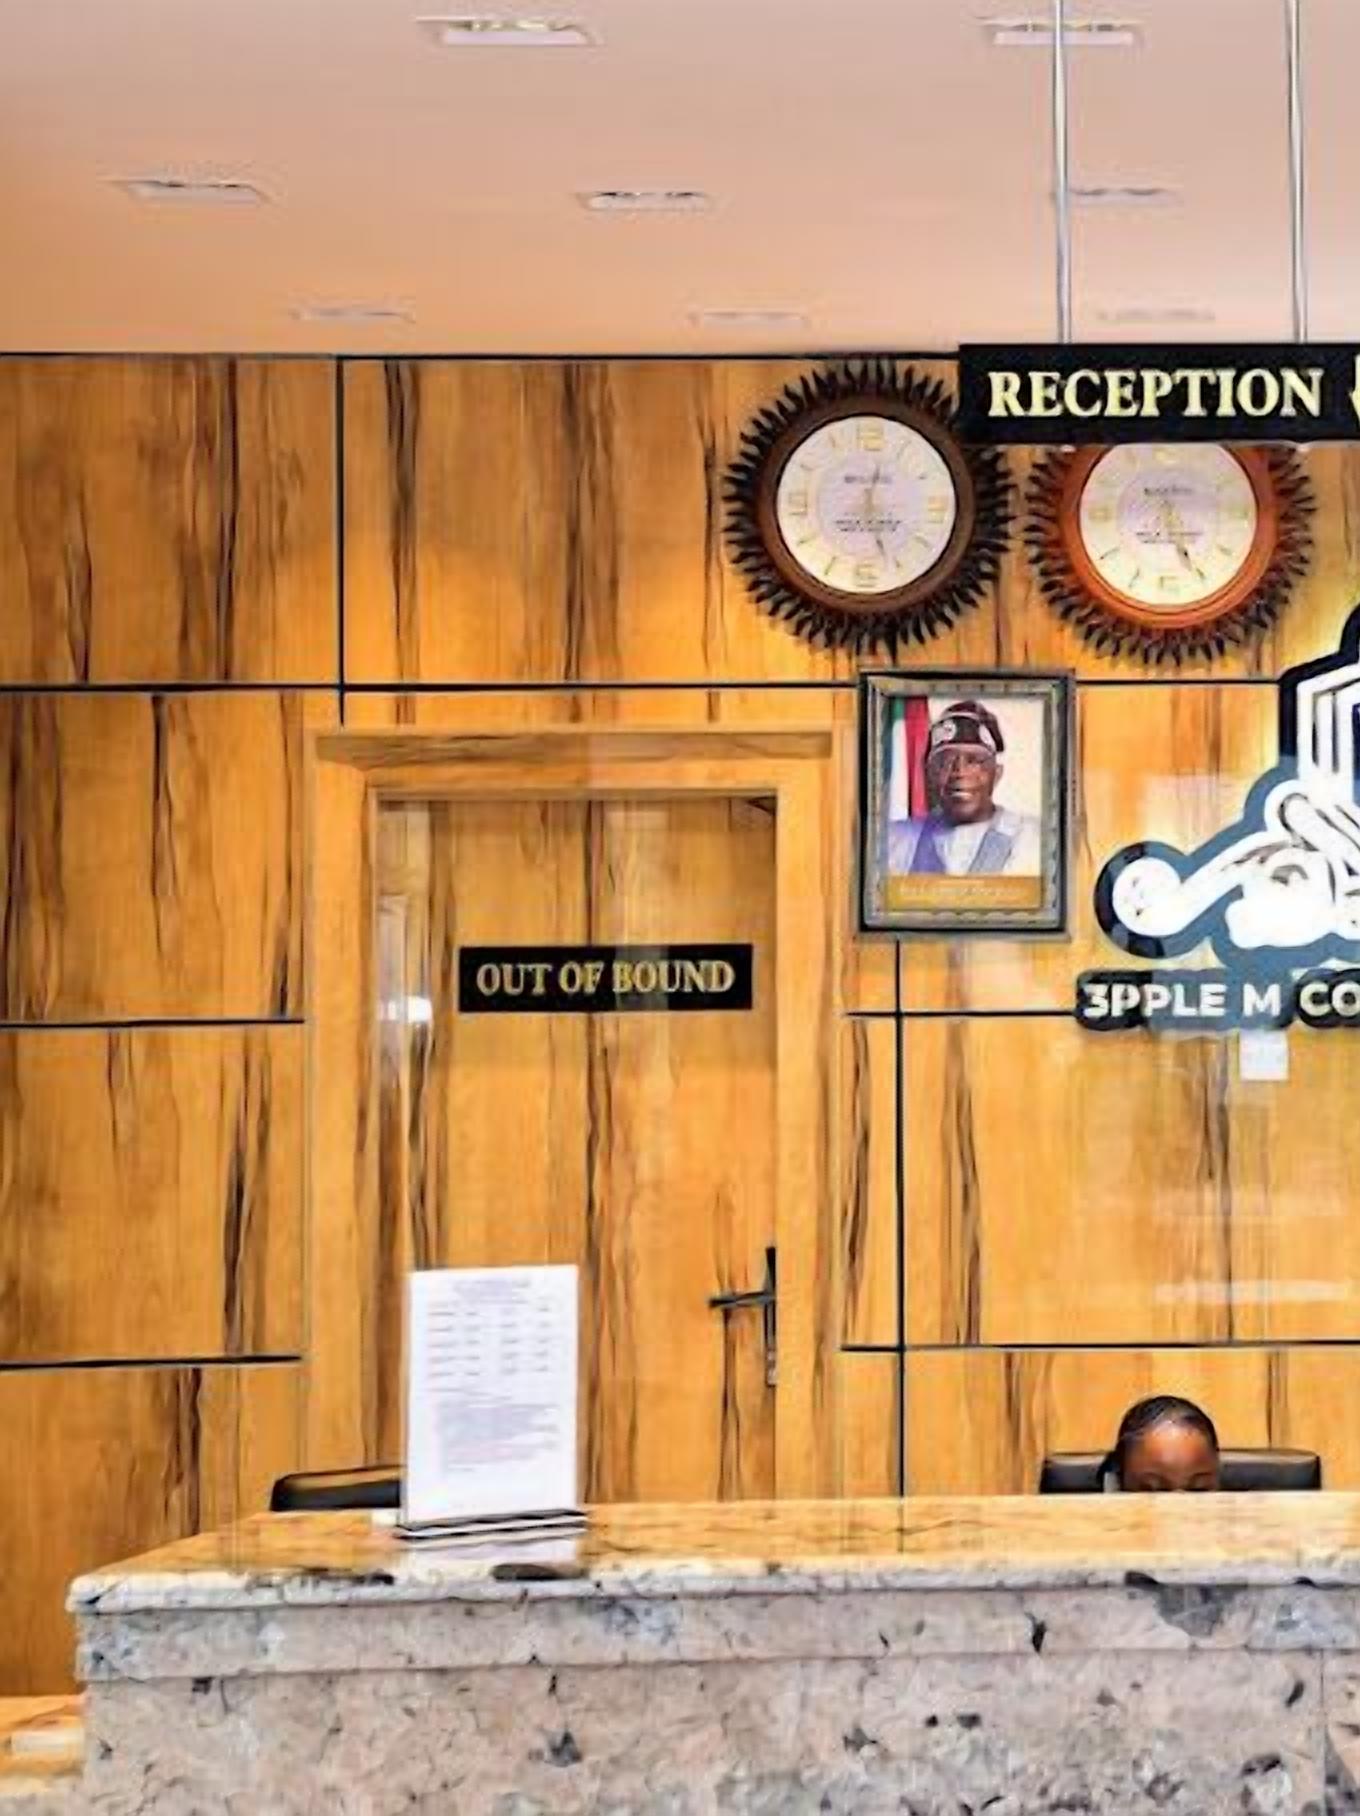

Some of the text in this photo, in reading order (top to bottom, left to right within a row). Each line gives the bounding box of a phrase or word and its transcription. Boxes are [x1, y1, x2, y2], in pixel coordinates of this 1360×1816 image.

[987, 368, 1325, 417] RECEPTION
[475, 959, 736, 996] OUT OF BOUND
[1083, 982, 1227, 1018] 3PPLE
[1242, 982, 1282, 1017] M
